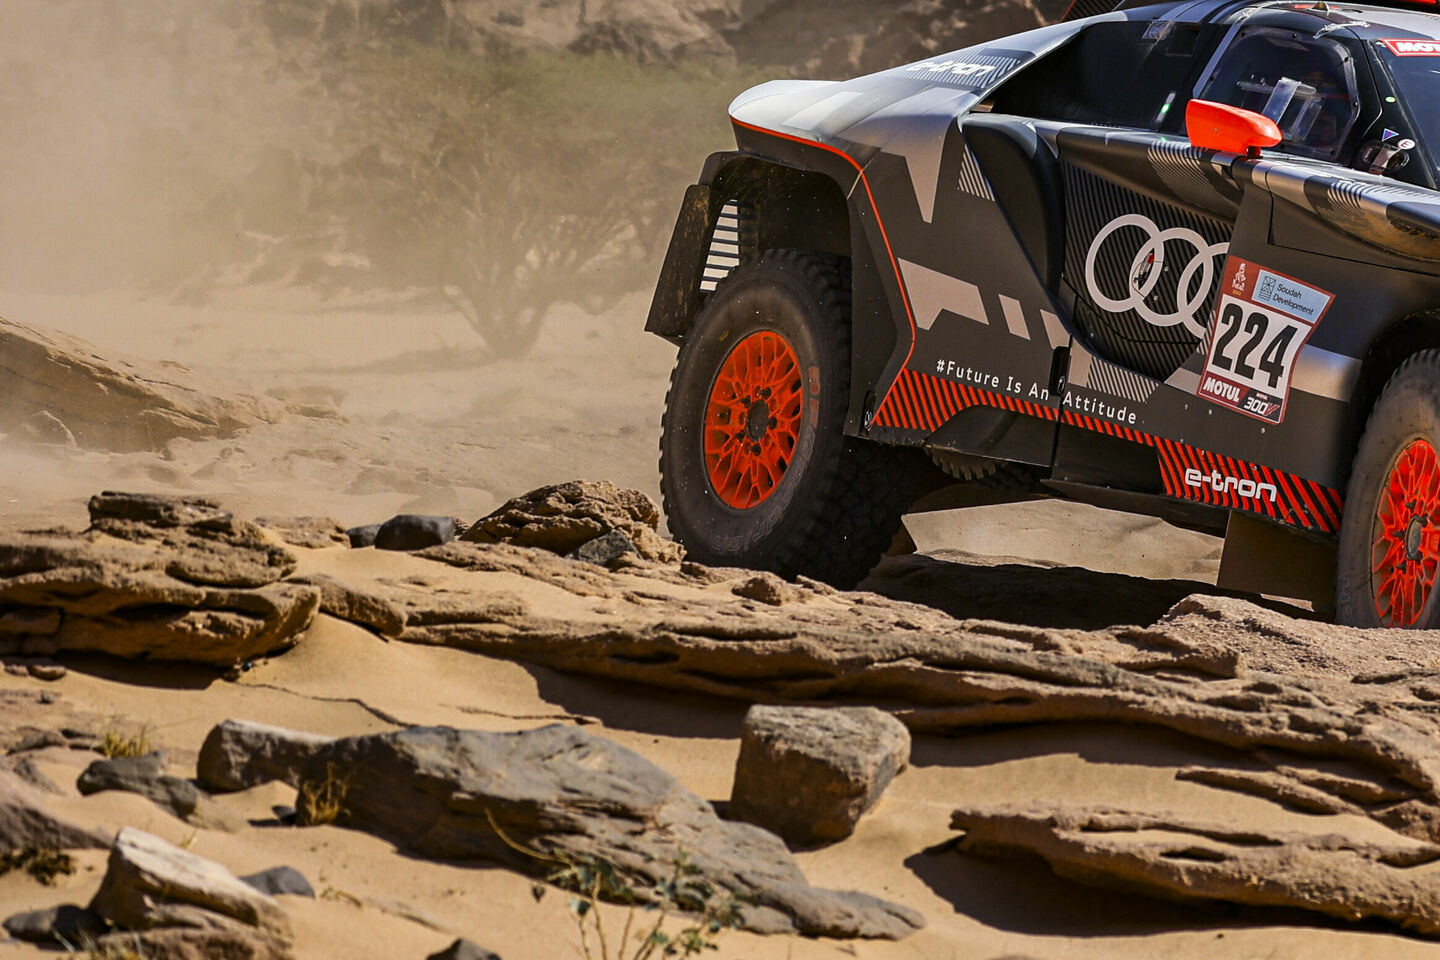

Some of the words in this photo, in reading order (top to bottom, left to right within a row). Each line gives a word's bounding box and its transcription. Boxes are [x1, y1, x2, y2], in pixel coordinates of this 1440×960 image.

[1276, 283, 1302, 299] Soudah
[1272, 293, 1314, 316] Development
[1212, 302, 1299, 389] 224
[936, 359, 1000, 388] #Future
[1006, 376, 1022, 393] Is
[1028, 382, 1050, 401] An
[1062, 391, 1137, 425] Attitude
[1203, 377, 1242, 403] MOTUL
[1244, 396, 1280, 416] 300V
[1185, 468, 1278, 503] e-tron
